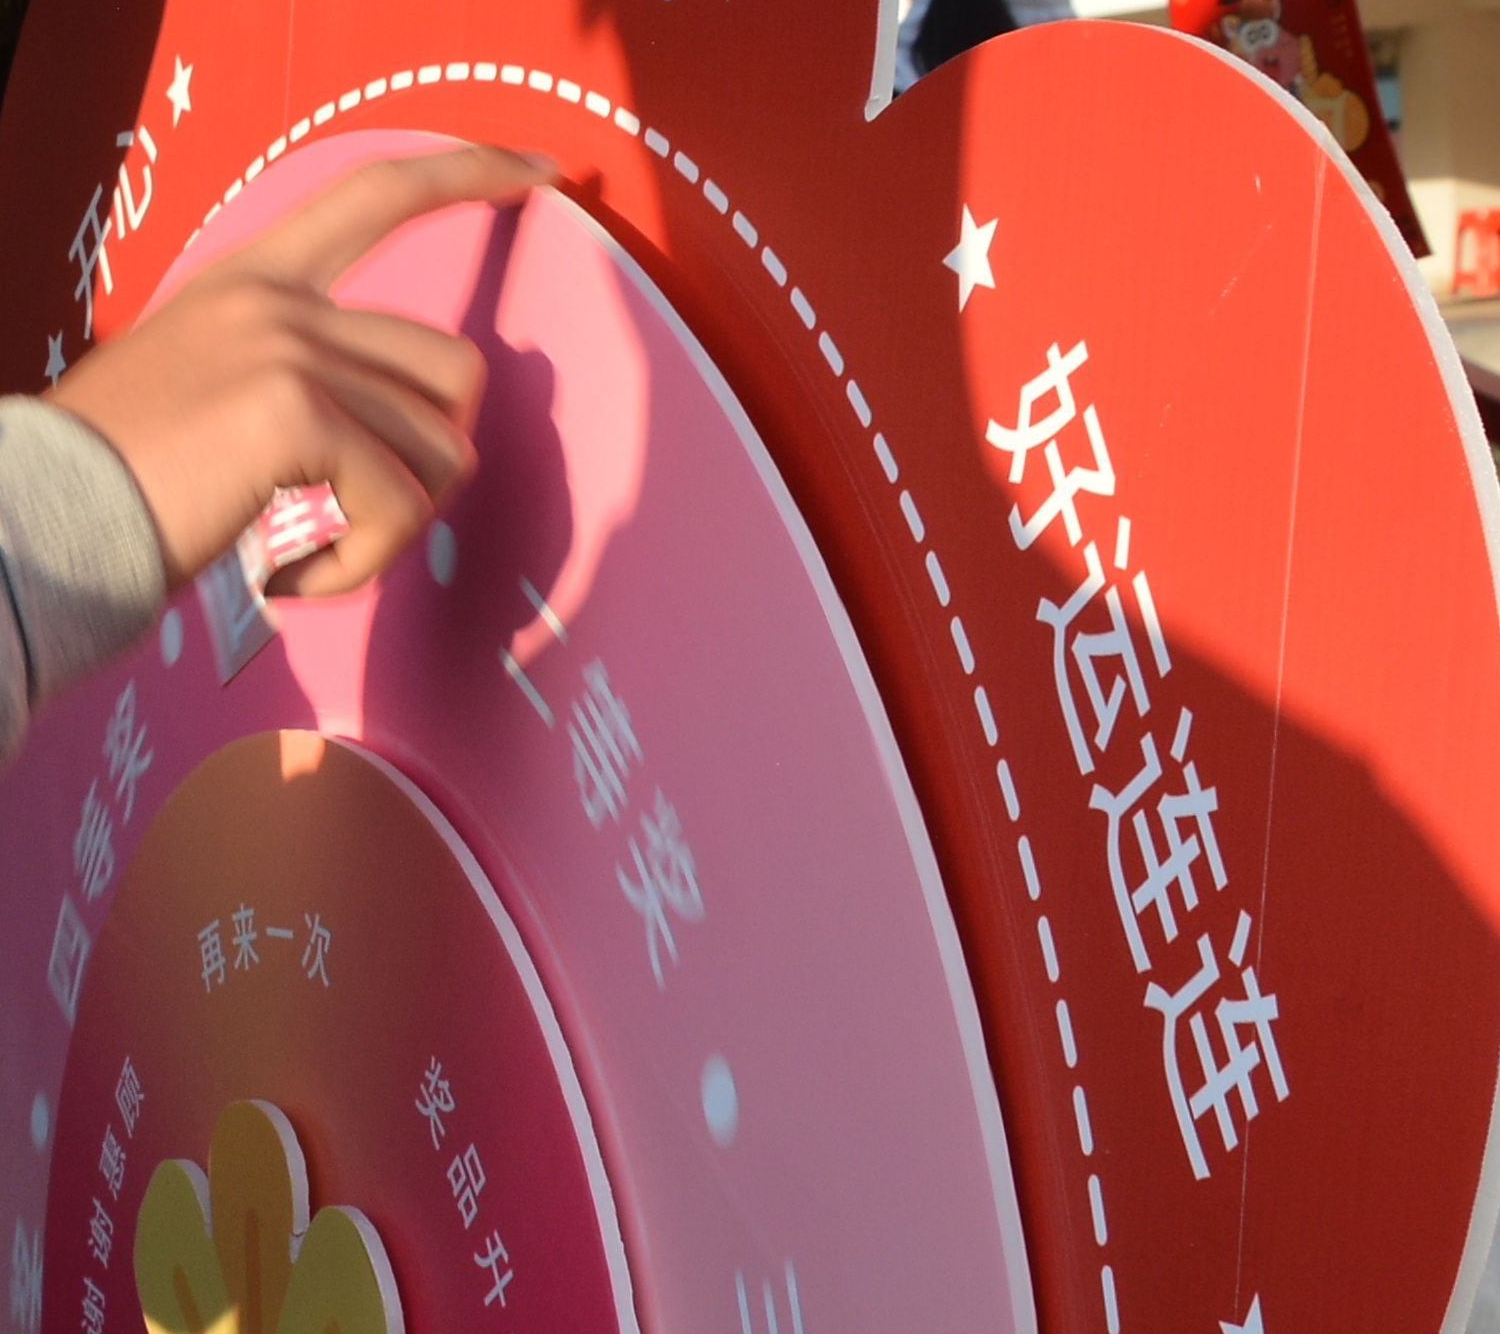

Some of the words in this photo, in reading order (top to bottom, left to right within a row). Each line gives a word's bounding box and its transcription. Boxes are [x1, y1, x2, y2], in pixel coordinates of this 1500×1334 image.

[69, 124, 158, 341] 开心
[47, 679, 155, 1030] 四等奖
[499, 572, 706, 993] 二等奖
[985, 339, 1290, 1181] 好运连连
[197, 901, 333, 993] 再来一次
